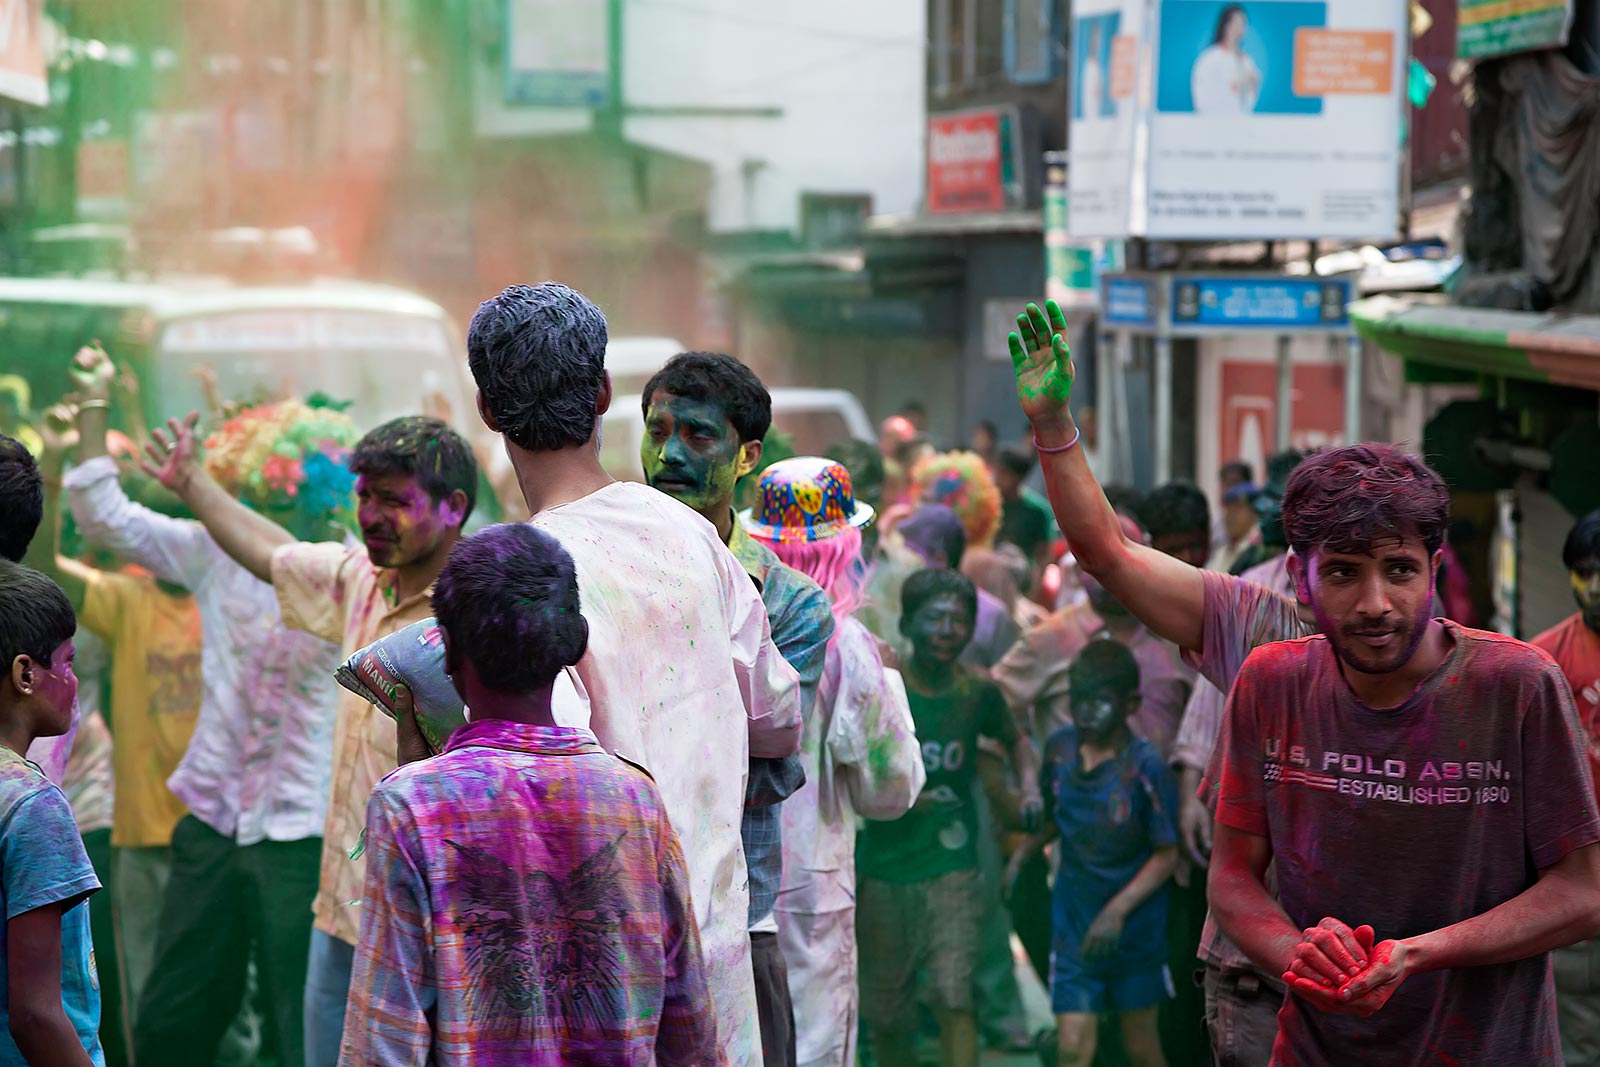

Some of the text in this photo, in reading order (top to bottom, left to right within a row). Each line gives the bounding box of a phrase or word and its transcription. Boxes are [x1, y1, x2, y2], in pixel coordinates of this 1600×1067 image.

[1322, 751, 1407, 779] POLO
[1338, 777, 1511, 805] ESTABLISHED 1890
